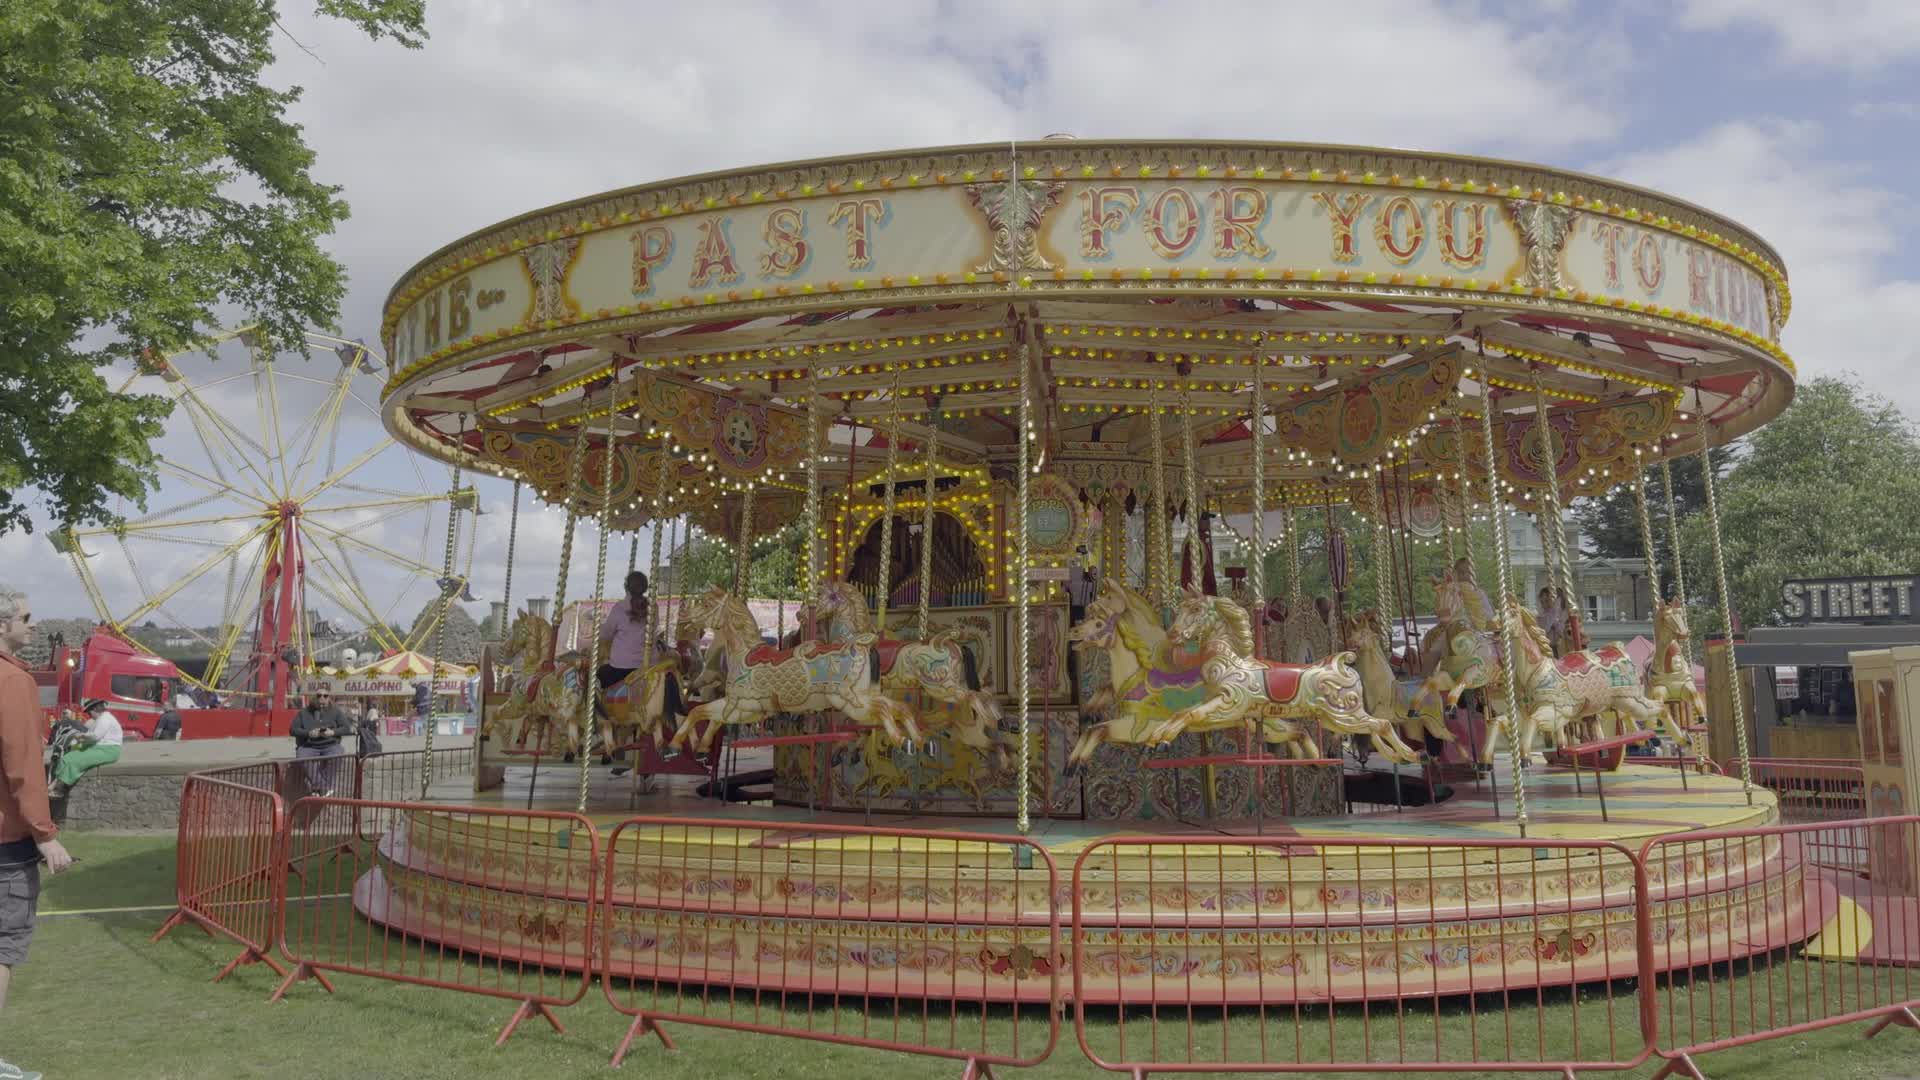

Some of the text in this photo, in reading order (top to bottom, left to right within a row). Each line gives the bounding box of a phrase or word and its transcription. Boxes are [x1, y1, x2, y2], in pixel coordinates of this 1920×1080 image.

[631, 199, 887, 296] PAST
[1077, 186, 1274, 262] FOR
[1312, 191, 1491, 274] YOU
[1591, 222, 1664, 296] TO
[1783, 580, 1913, 618] STREET
[344, 680, 402, 692] GALLOPING
